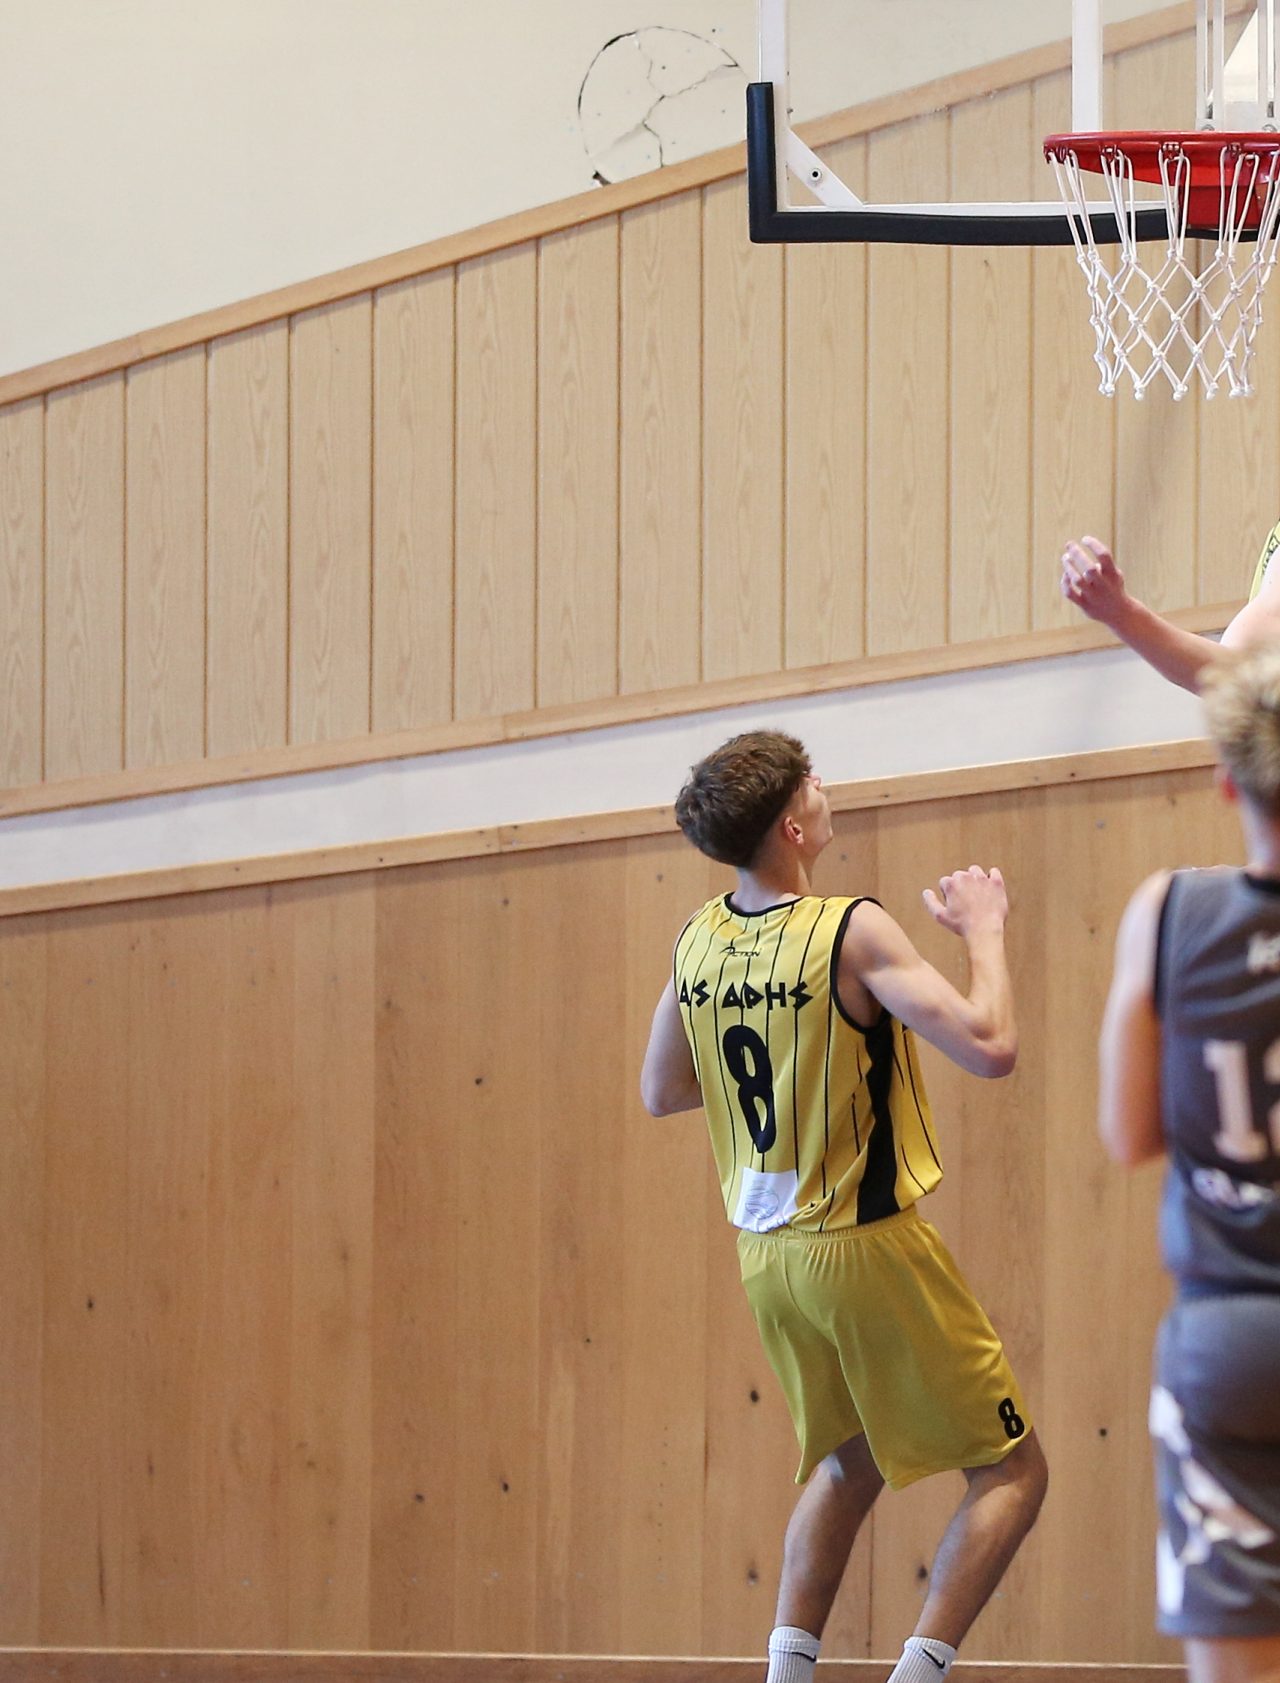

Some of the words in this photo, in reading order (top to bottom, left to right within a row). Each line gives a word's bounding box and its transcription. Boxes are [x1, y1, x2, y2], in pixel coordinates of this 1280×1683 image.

[679, 977, 711, 1008] AS
[722, 980, 814, 1011] ADHS
[722, 1024, 777, 1154] 8
[997, 1397, 1025, 1440] 8
